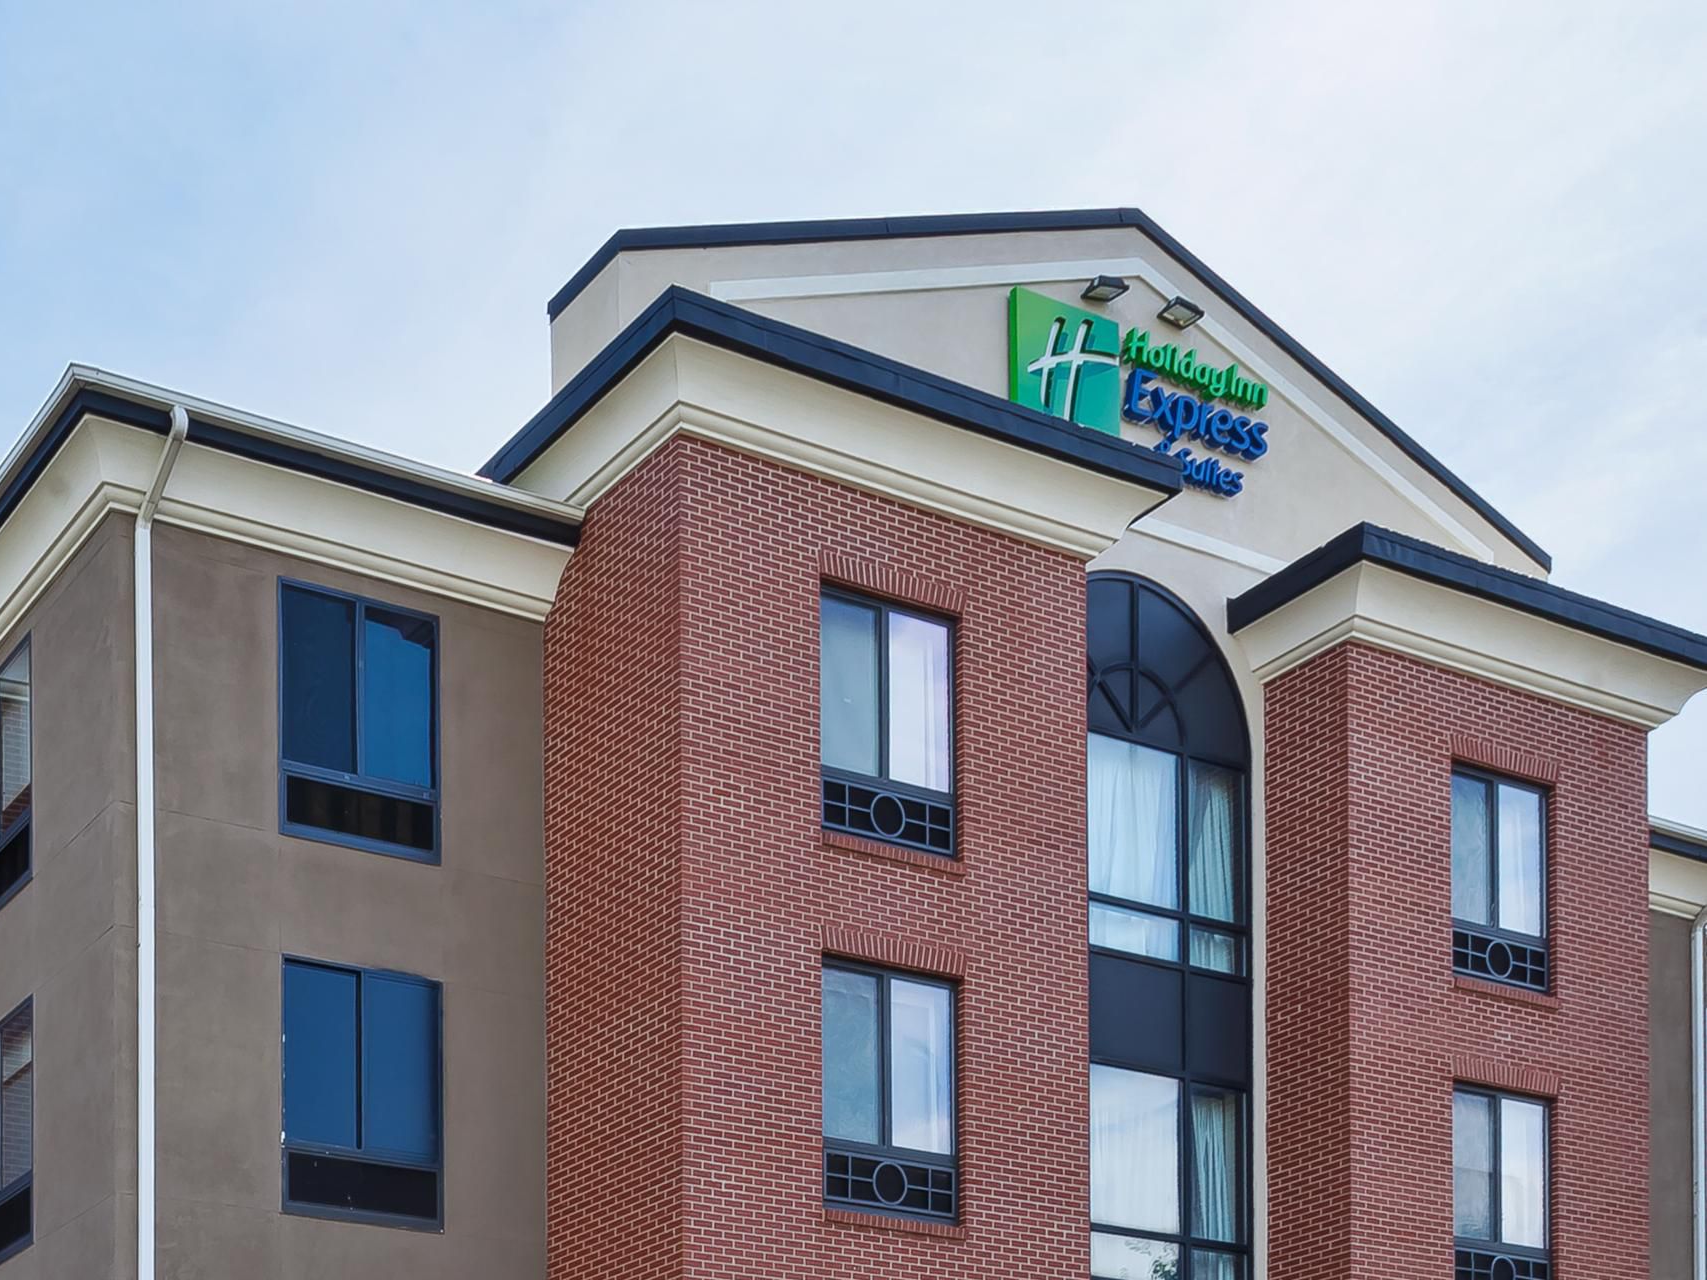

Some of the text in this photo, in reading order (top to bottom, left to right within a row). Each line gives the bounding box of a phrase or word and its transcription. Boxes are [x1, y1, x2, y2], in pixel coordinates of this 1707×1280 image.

[1126, 327, 1269, 409] Holiday Inn
[1126, 367, 1269, 459] Express
[1178, 447, 1244, 496] Suites
